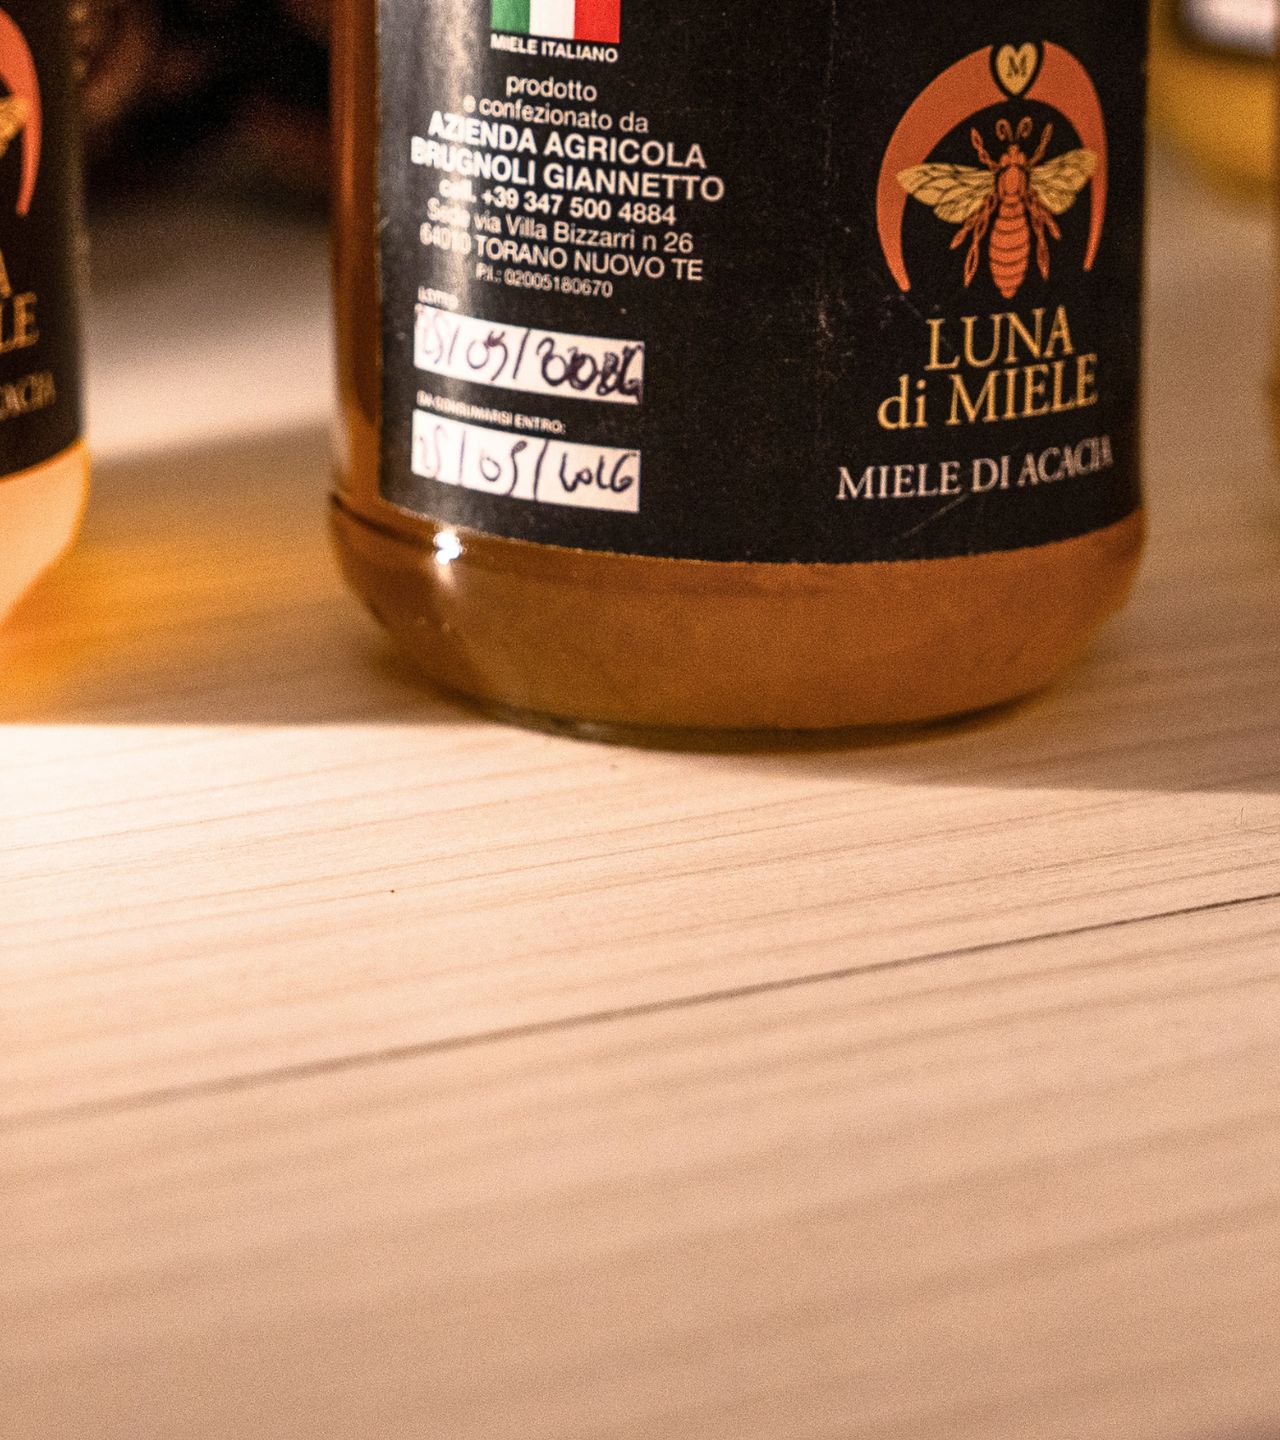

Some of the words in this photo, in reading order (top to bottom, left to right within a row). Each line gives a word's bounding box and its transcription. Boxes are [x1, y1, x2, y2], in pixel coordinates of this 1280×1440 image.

[491, 33, 538, 56] MIELE
[541, 41, 618, 63] ITALIANO
[1005, 55, 1027, 79] M
[506, 75, 597, 102] prodotto
[479, 97, 612, 130] confezionato
[620, 111, 649, 133] da
[428, 110, 537, 155] AZIENDA
[543, 131, 706, 169] AGRICOLA
[411, 137, 535, 186] BRUGNOLI
[543, 162, 725, 202] GIANNETTO
[481, 186, 518, 210] +39
[524, 190, 562, 214] 347
[570, 197, 612, 220] 500
[617, 203, 676, 226] 4884
[474, 212, 501, 233] via
[505, 214, 547, 240] Villa
[554, 221, 635, 249] Bizzarri
[642, 234, 656, 251] n
[664, 232, 693, 253] 26
[475, 235, 568, 269] TORANO
[574, 252, 665, 279] NUOVO
[672, 258, 704, 281] TE
[504, 268, 613, 298] 02005180670
[925, 304, 1074, 372] LUNA
[877, 373, 928, 431] di
[945, 354, 1098, 427] MIELE
[514, 414, 567, 435] ENTRO:
[836, 460, 962, 501] MIELE
[971, 455, 1010, 493] DI
